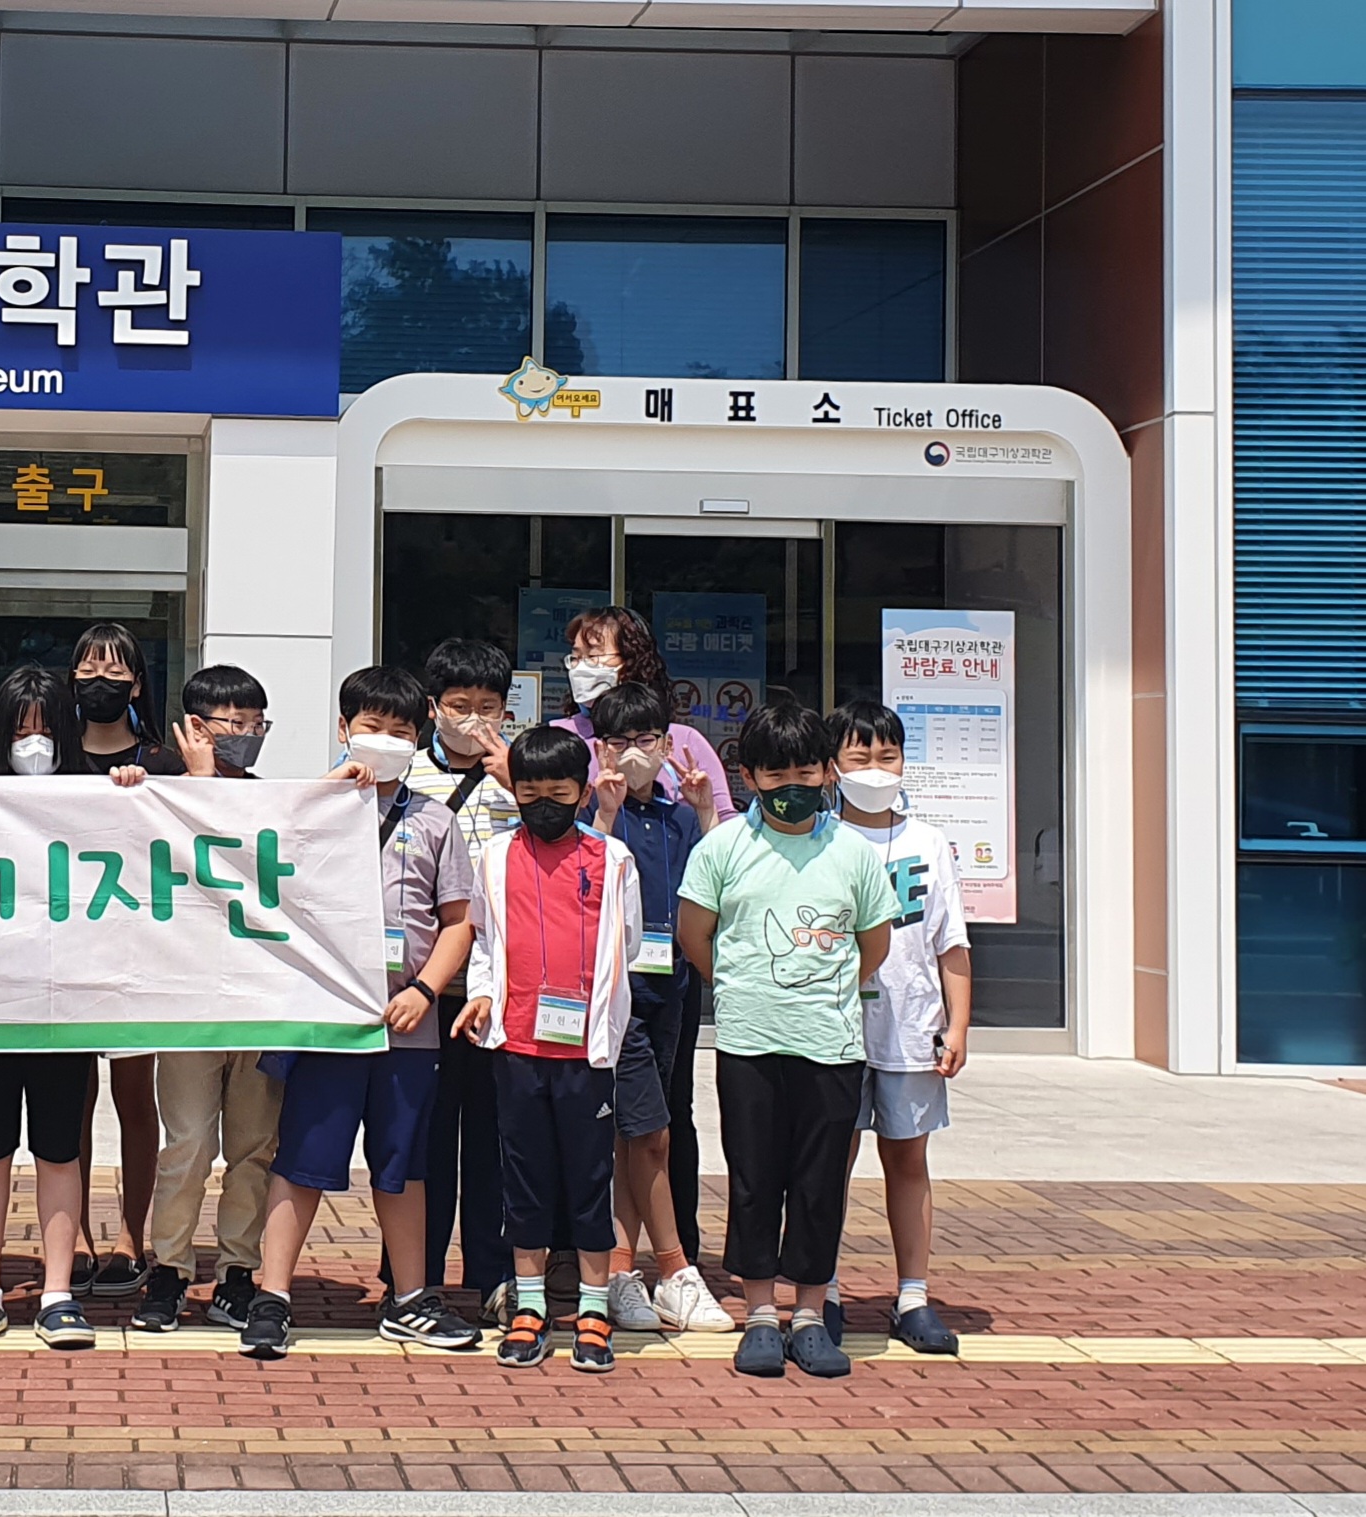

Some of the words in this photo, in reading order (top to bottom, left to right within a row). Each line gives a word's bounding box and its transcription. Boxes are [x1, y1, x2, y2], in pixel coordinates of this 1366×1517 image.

[874, 407, 933, 428] Ticket
[946, 408, 1002, 429] Office
[955, 446, 1053, 460] 국립대구기상과학관
[11, 463, 109, 512] 출구
[703, 633, 754, 652] 에티켓
[894, 639, 1004, 654] 국립대구기상과학관
[901, 657, 957, 677] 관람료
[962, 658, 998, 678] 안내
